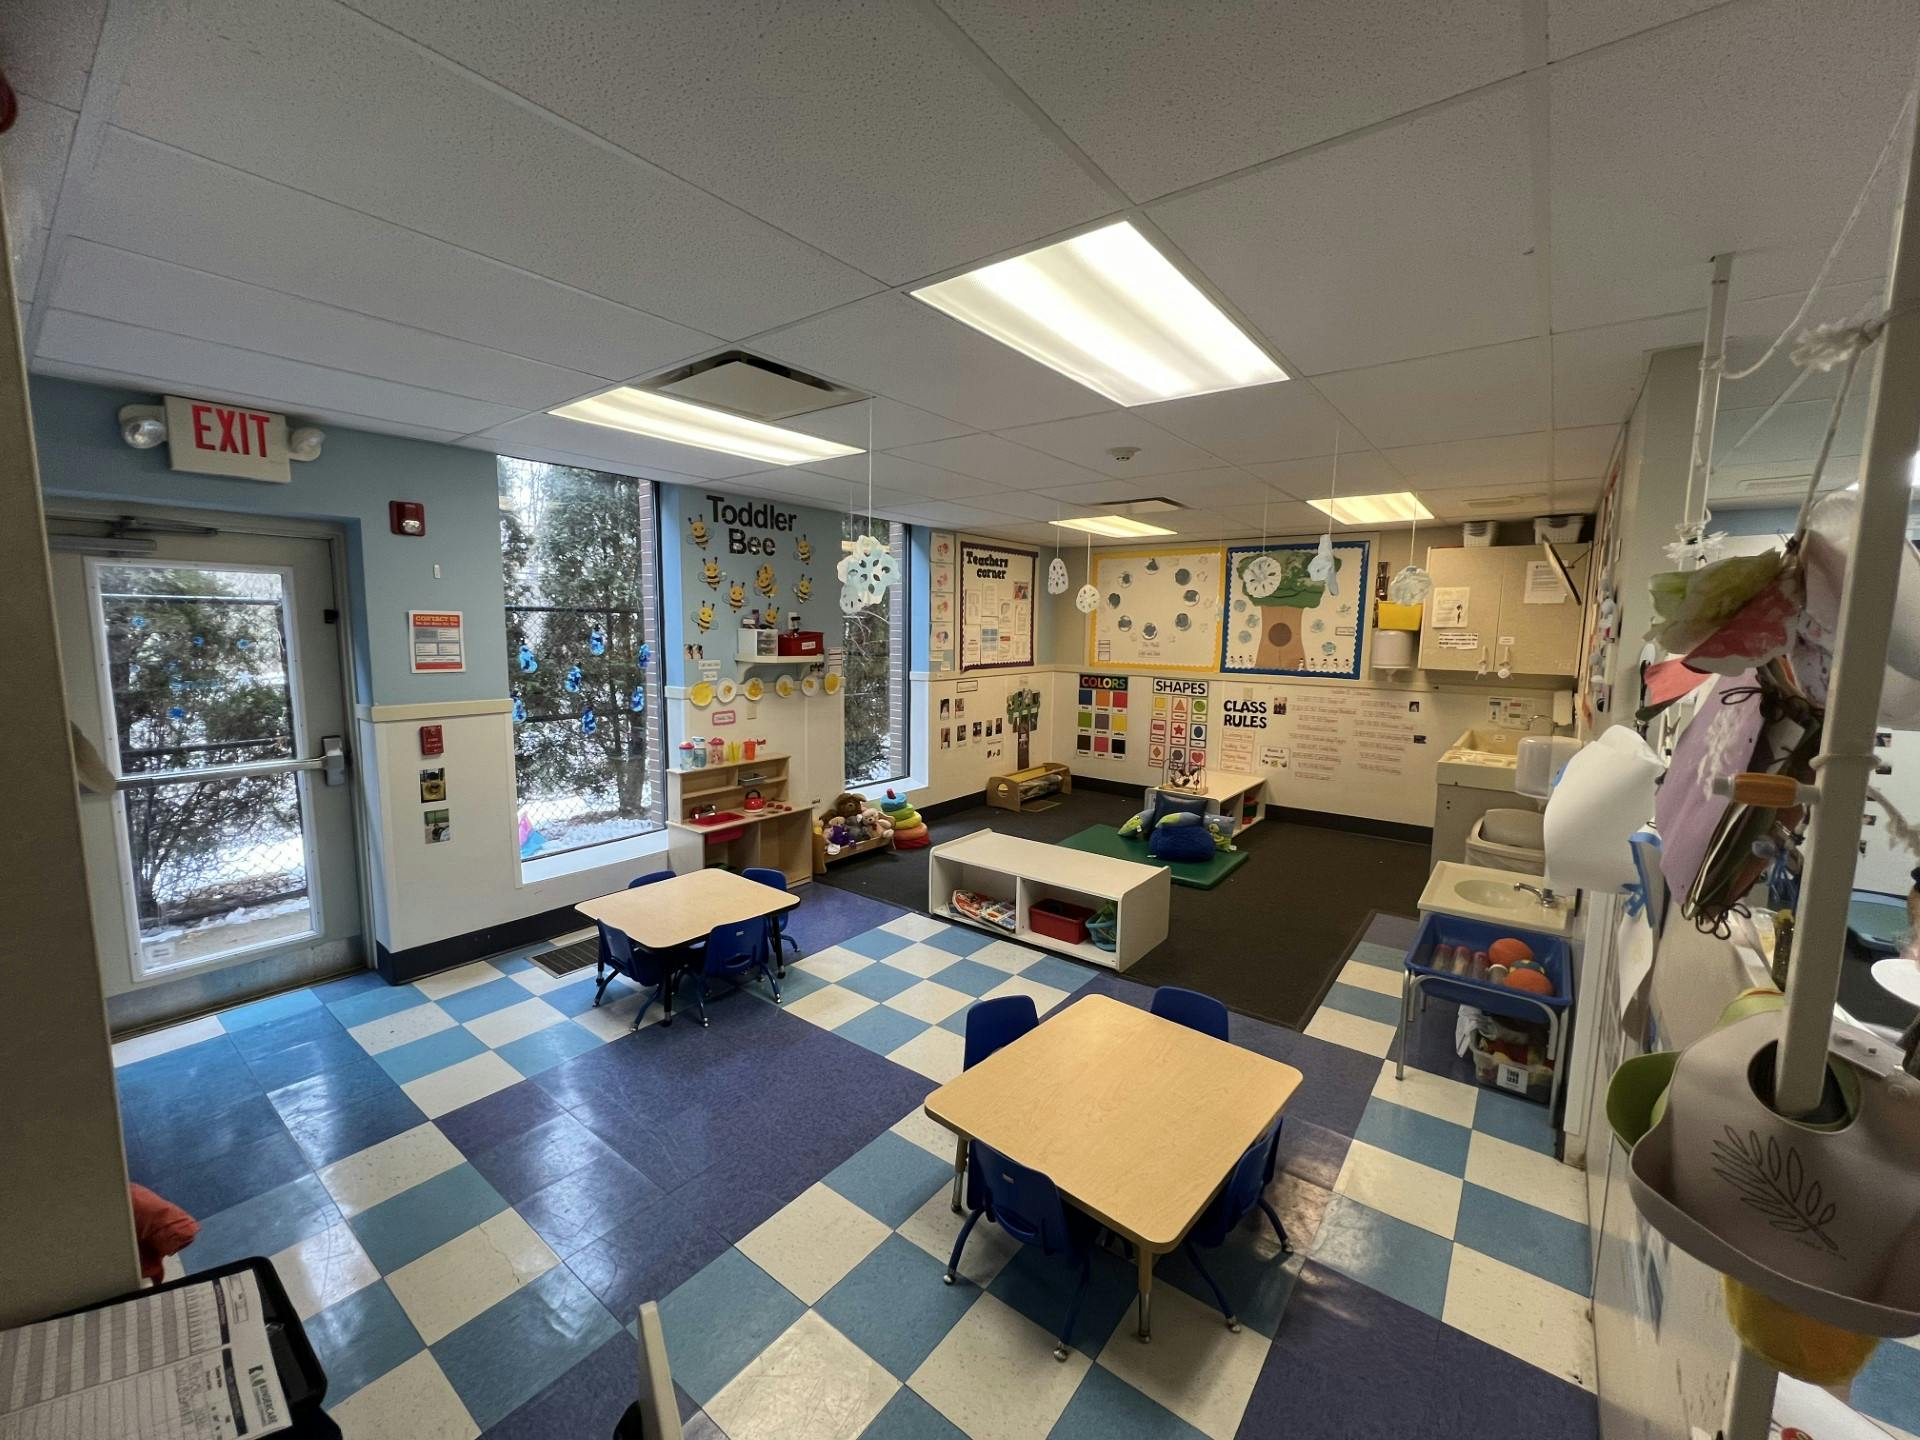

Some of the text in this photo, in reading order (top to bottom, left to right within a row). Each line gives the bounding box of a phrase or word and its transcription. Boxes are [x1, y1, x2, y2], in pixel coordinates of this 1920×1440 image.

[192, 405, 270, 458] EXIT
[706, 495, 797, 532] Toddler
[728, 528, 776, 557] Bee
[966, 551, 1009, 568] Teachers
[976, 568, 1007, 580] corner
[1081, 676, 1126, 690] COLORS
[1155, 680, 1206, 695] SHAPES
[1223, 699, 1267, 714] CLASS
[1223, 714, 1267, 729] RULES
